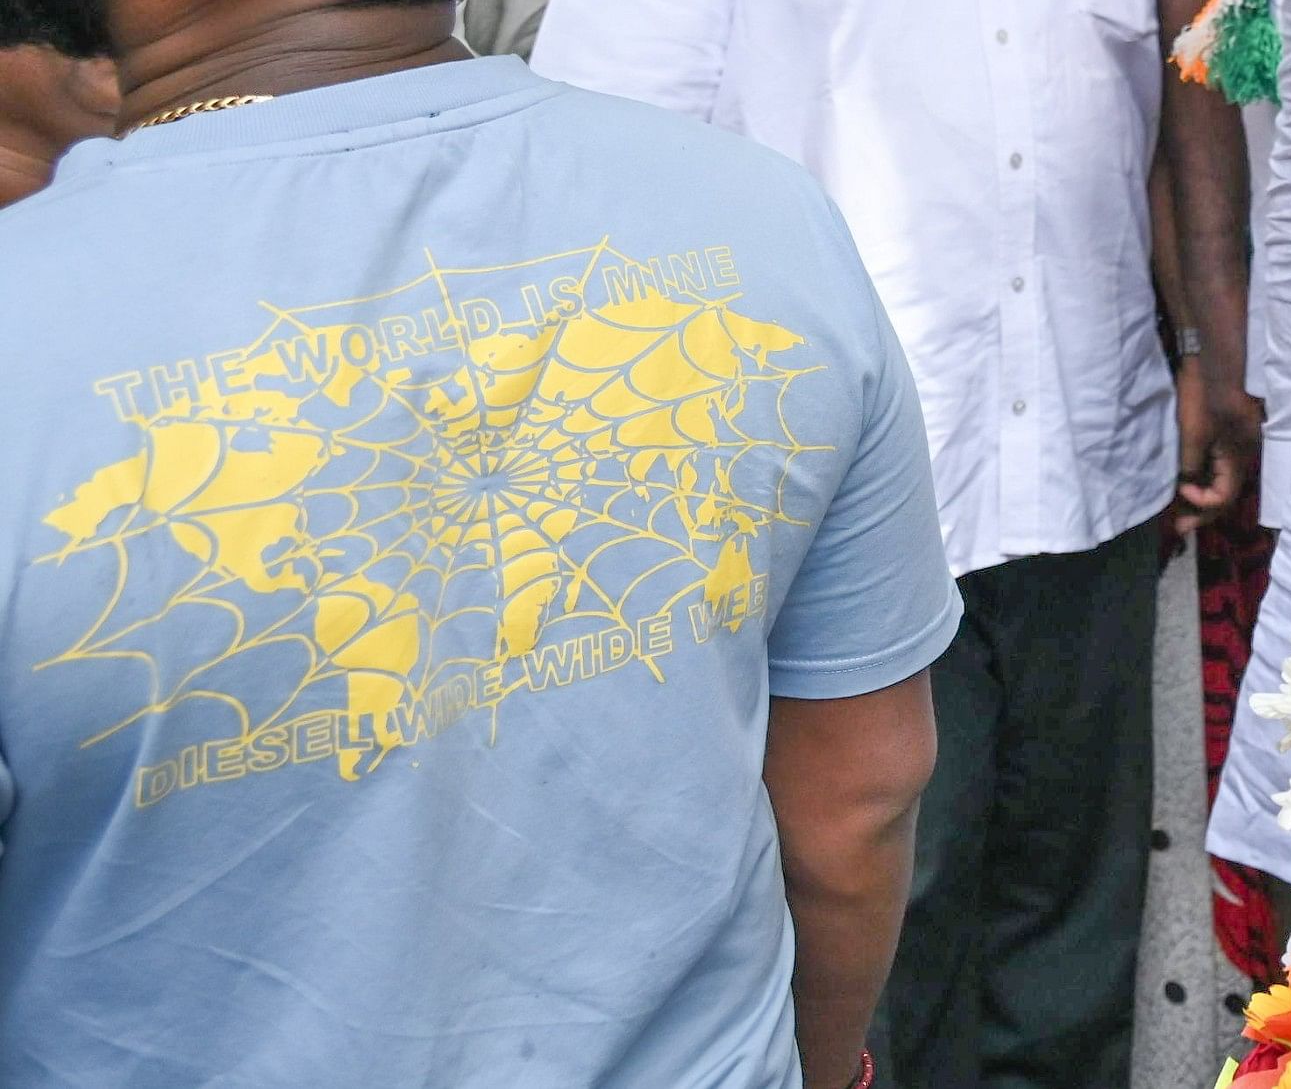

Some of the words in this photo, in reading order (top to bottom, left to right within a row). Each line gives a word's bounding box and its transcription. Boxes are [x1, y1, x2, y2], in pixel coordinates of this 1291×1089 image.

[94, 351, 253, 422] THE
[272, 298, 502, 382] WORLD
[520, 276, 585, 327] IS
[602, 246, 741, 306] MINE
[136, 713, 373, 808] DIESEL
[394, 661, 502, 746] WIDE
[523, 612, 672, 692] WIDE
[688, 573, 768, 644] WEB
